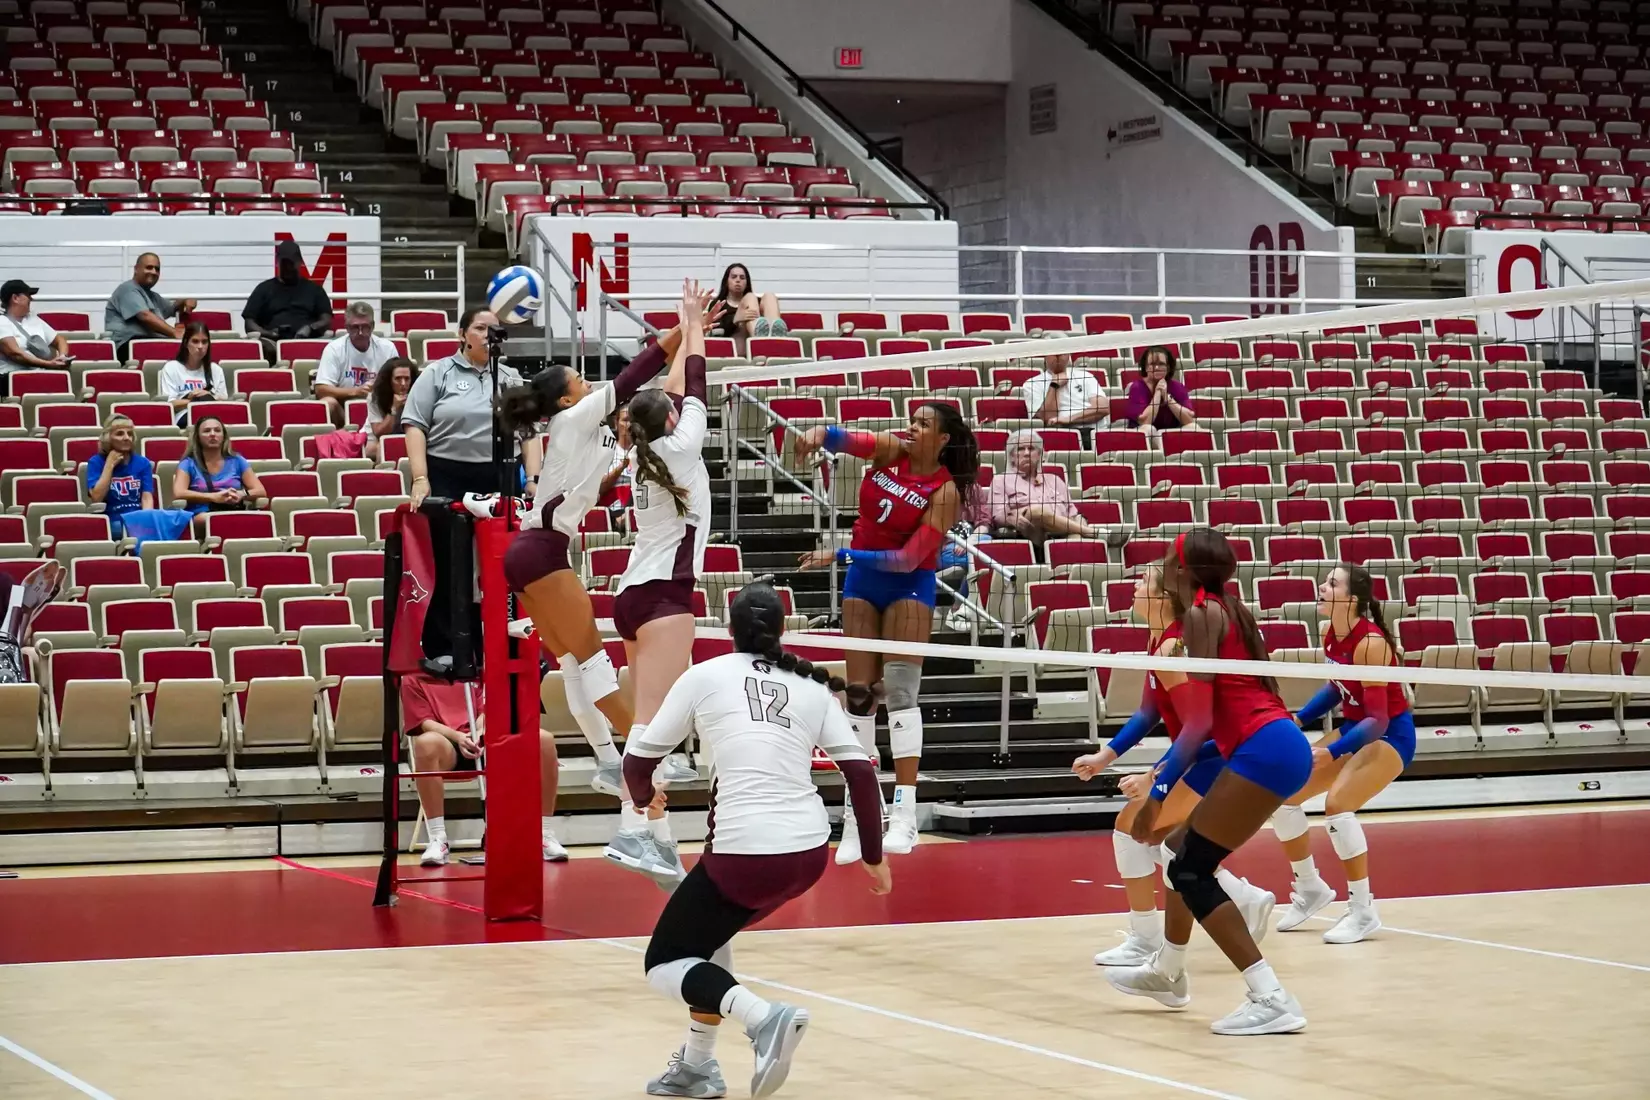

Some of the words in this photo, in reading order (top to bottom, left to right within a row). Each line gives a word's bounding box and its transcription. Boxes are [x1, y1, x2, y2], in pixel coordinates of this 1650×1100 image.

[226, 26, 238, 36] 19
[244, 52, 257, 62] 18
[841, 48, 862, 65] EXIT
[266, 80, 279, 90] 17
[289, 111, 302, 121] 16
[313, 141, 327, 152] 15
[339, 171, 353, 182] 14
[368, 204, 381, 214] 13
[274, 232, 347, 310] M
[424, 269, 435, 280] 11
[572, 232, 629, 311] N
[1366, 276, 1376, 287] 11
[904, 490, 929, 510] TECH
[744, 676, 791, 729] 12
